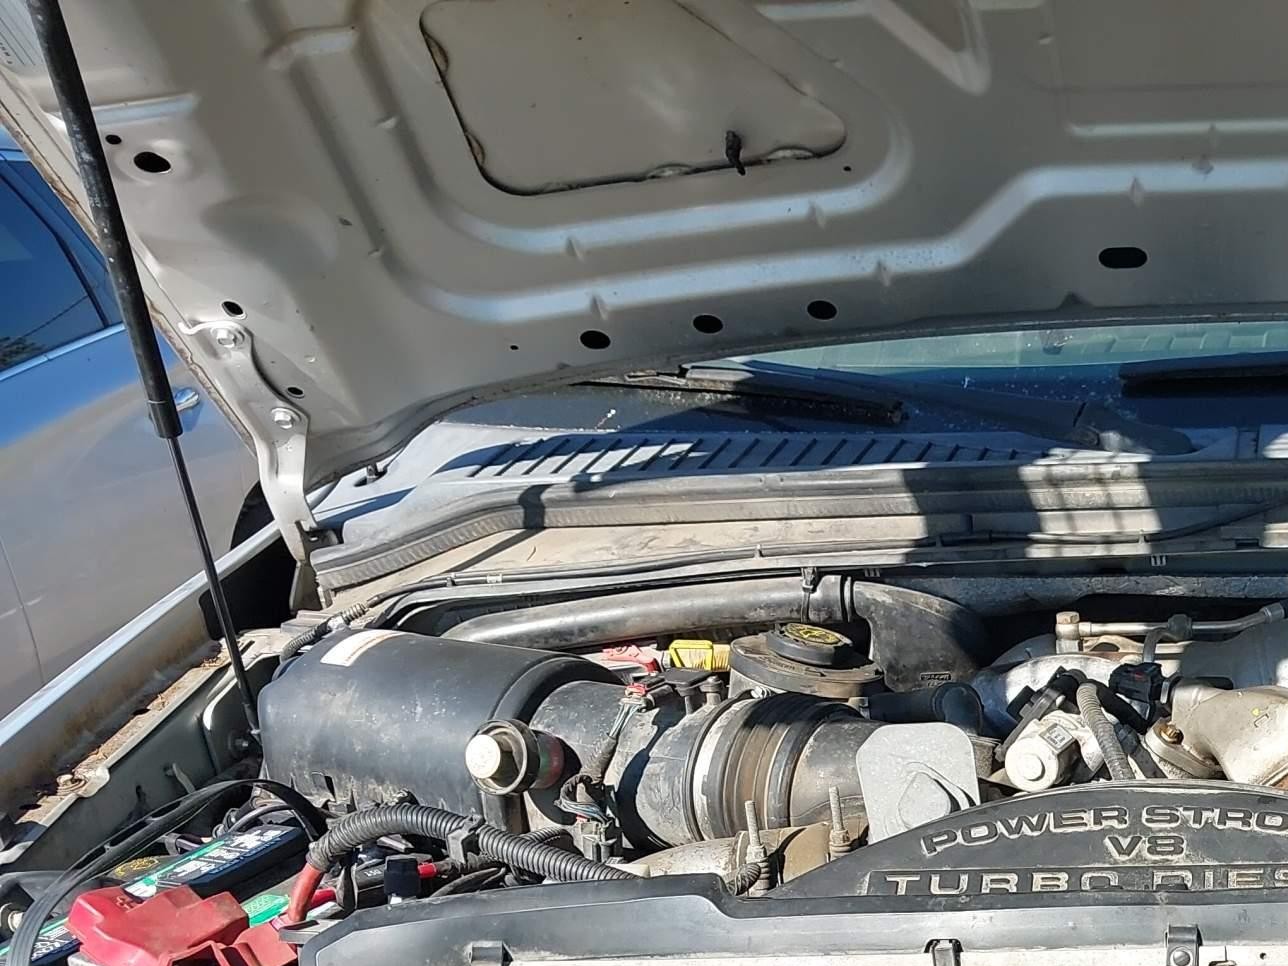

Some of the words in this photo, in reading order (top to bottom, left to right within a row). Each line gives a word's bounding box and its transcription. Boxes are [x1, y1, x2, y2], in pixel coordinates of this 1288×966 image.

[920, 804, 1128, 857] POWER
[1105, 833, 1188, 859] V8
[884, 869, 1124, 896] TURBO
